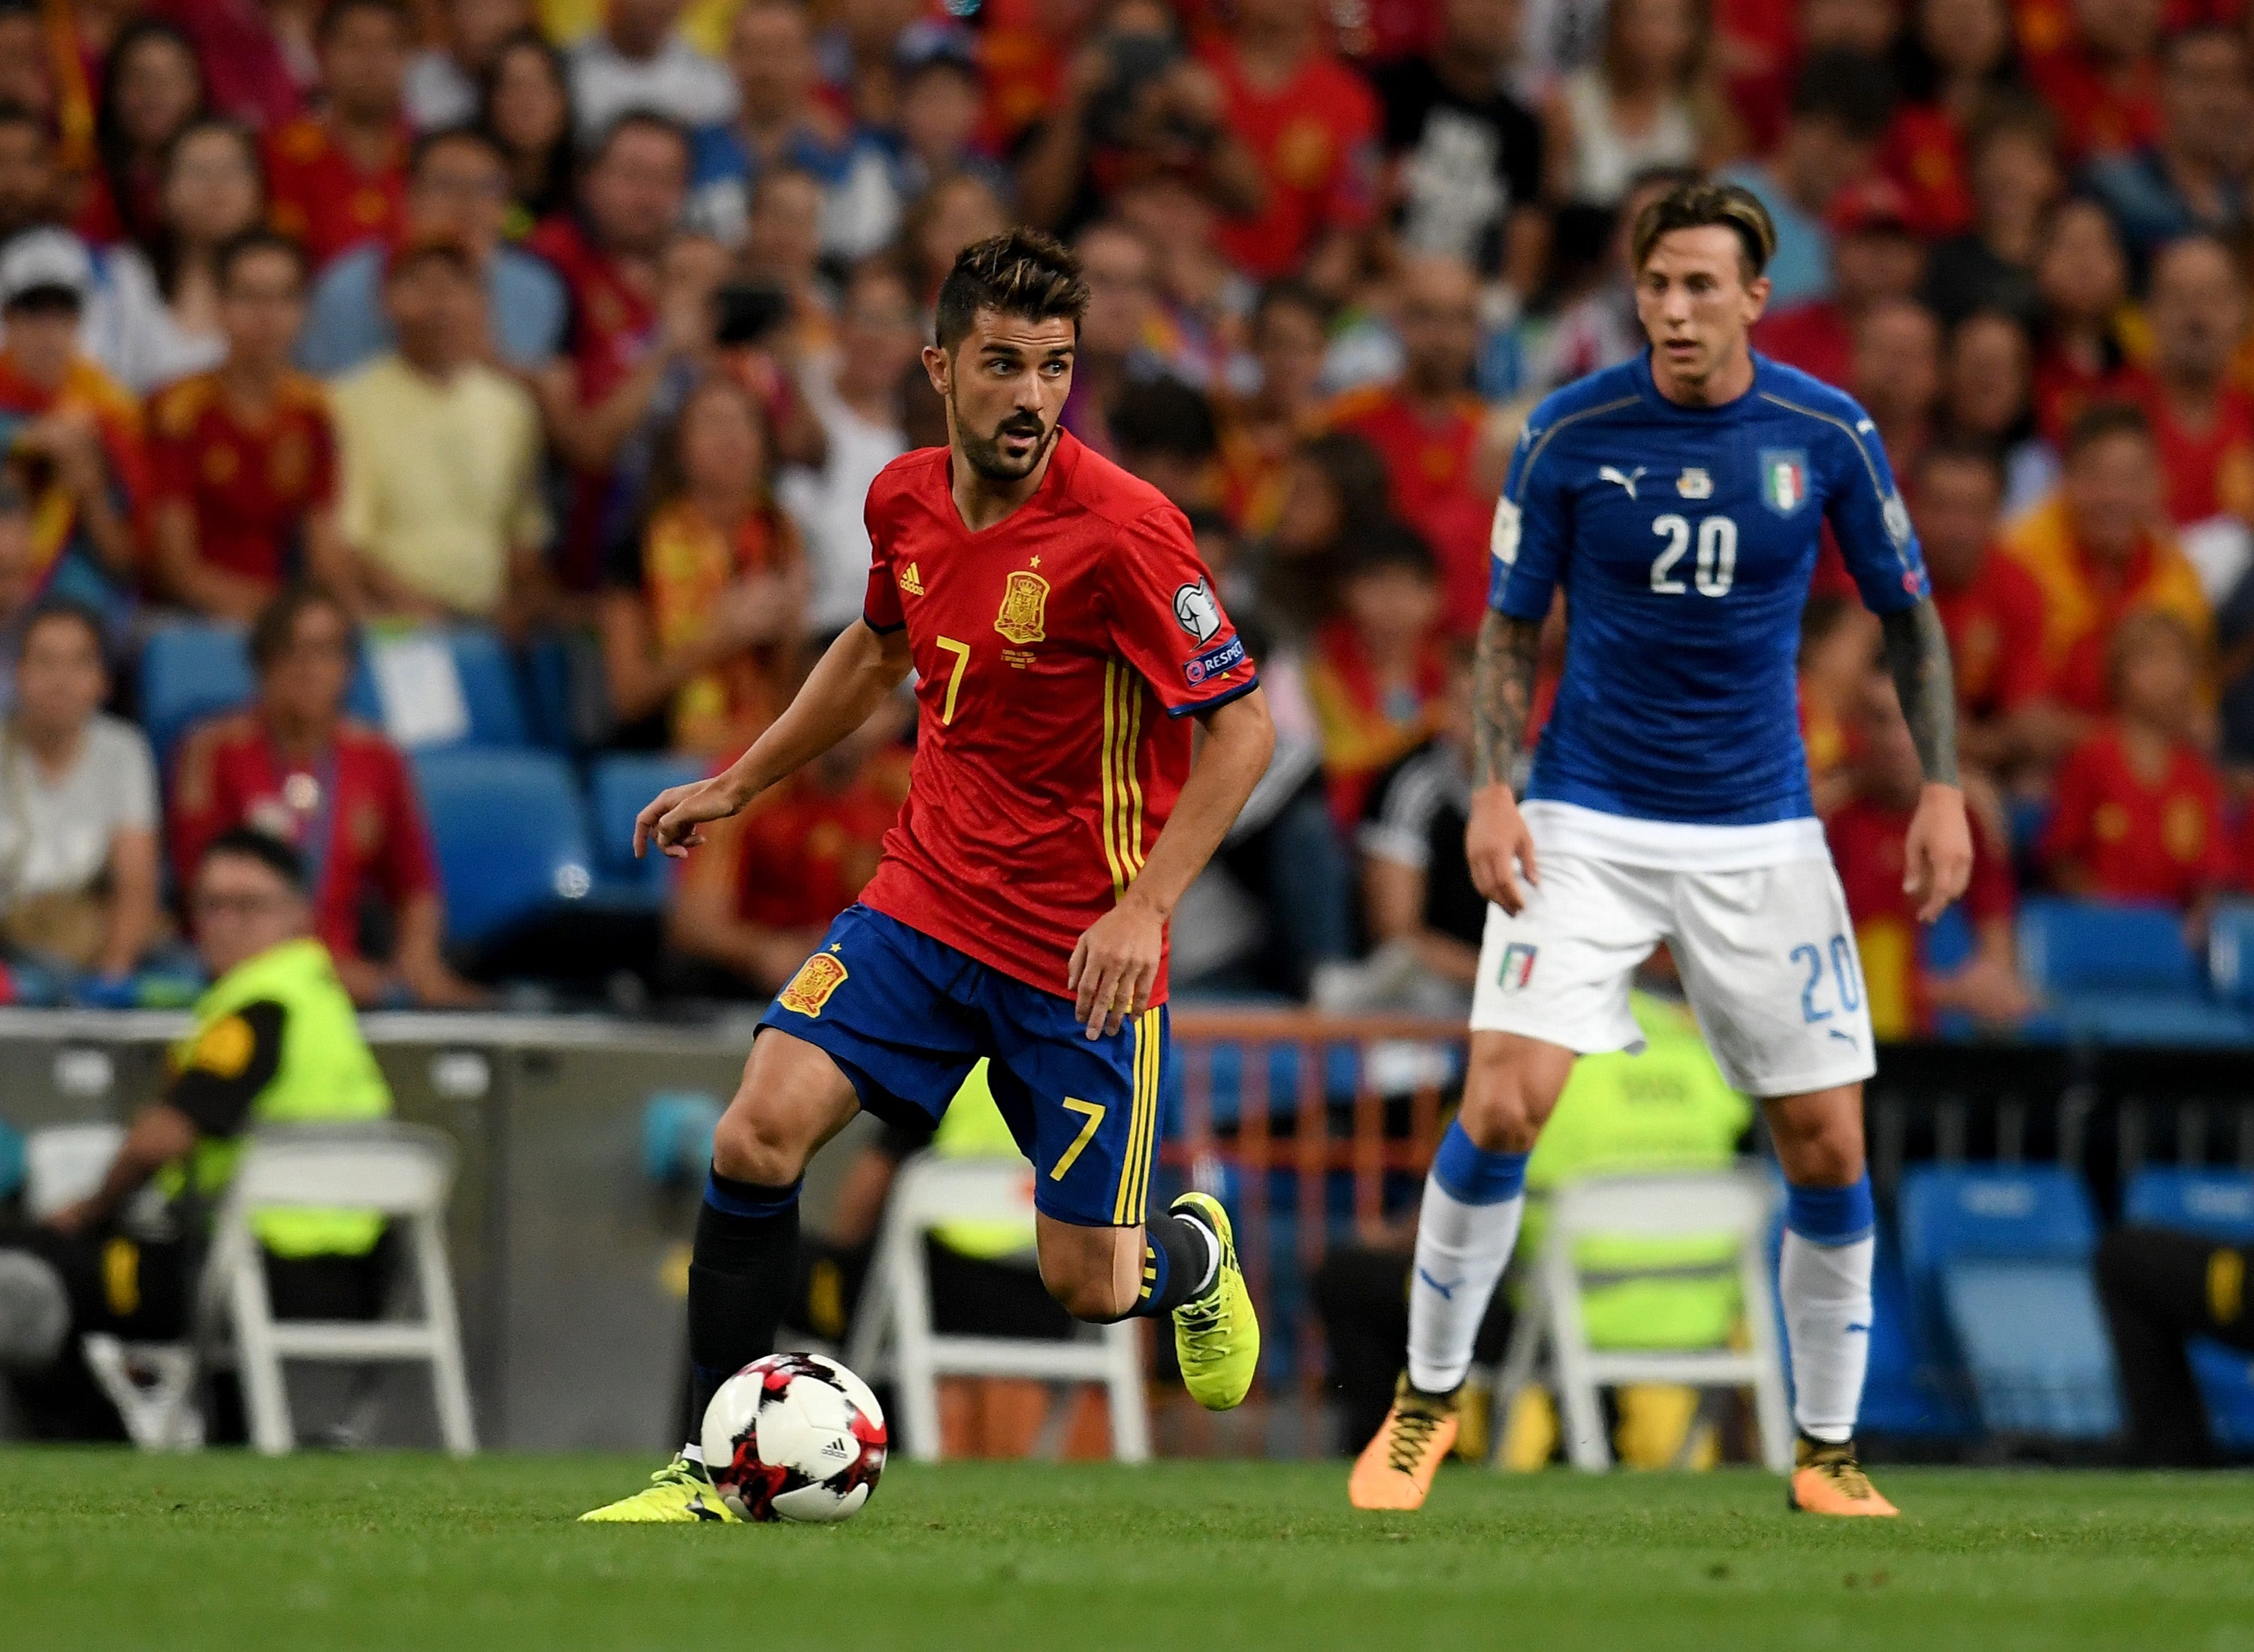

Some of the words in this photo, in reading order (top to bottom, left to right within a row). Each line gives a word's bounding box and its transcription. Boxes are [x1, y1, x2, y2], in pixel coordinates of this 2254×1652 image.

[900, 579, 924, 596] adidas
[1650, 514, 1737, 598] 20
[936, 635, 970, 726] 7
[1789, 935, 1859, 1023] 20
[1050, 1096, 1106, 1182] 7
